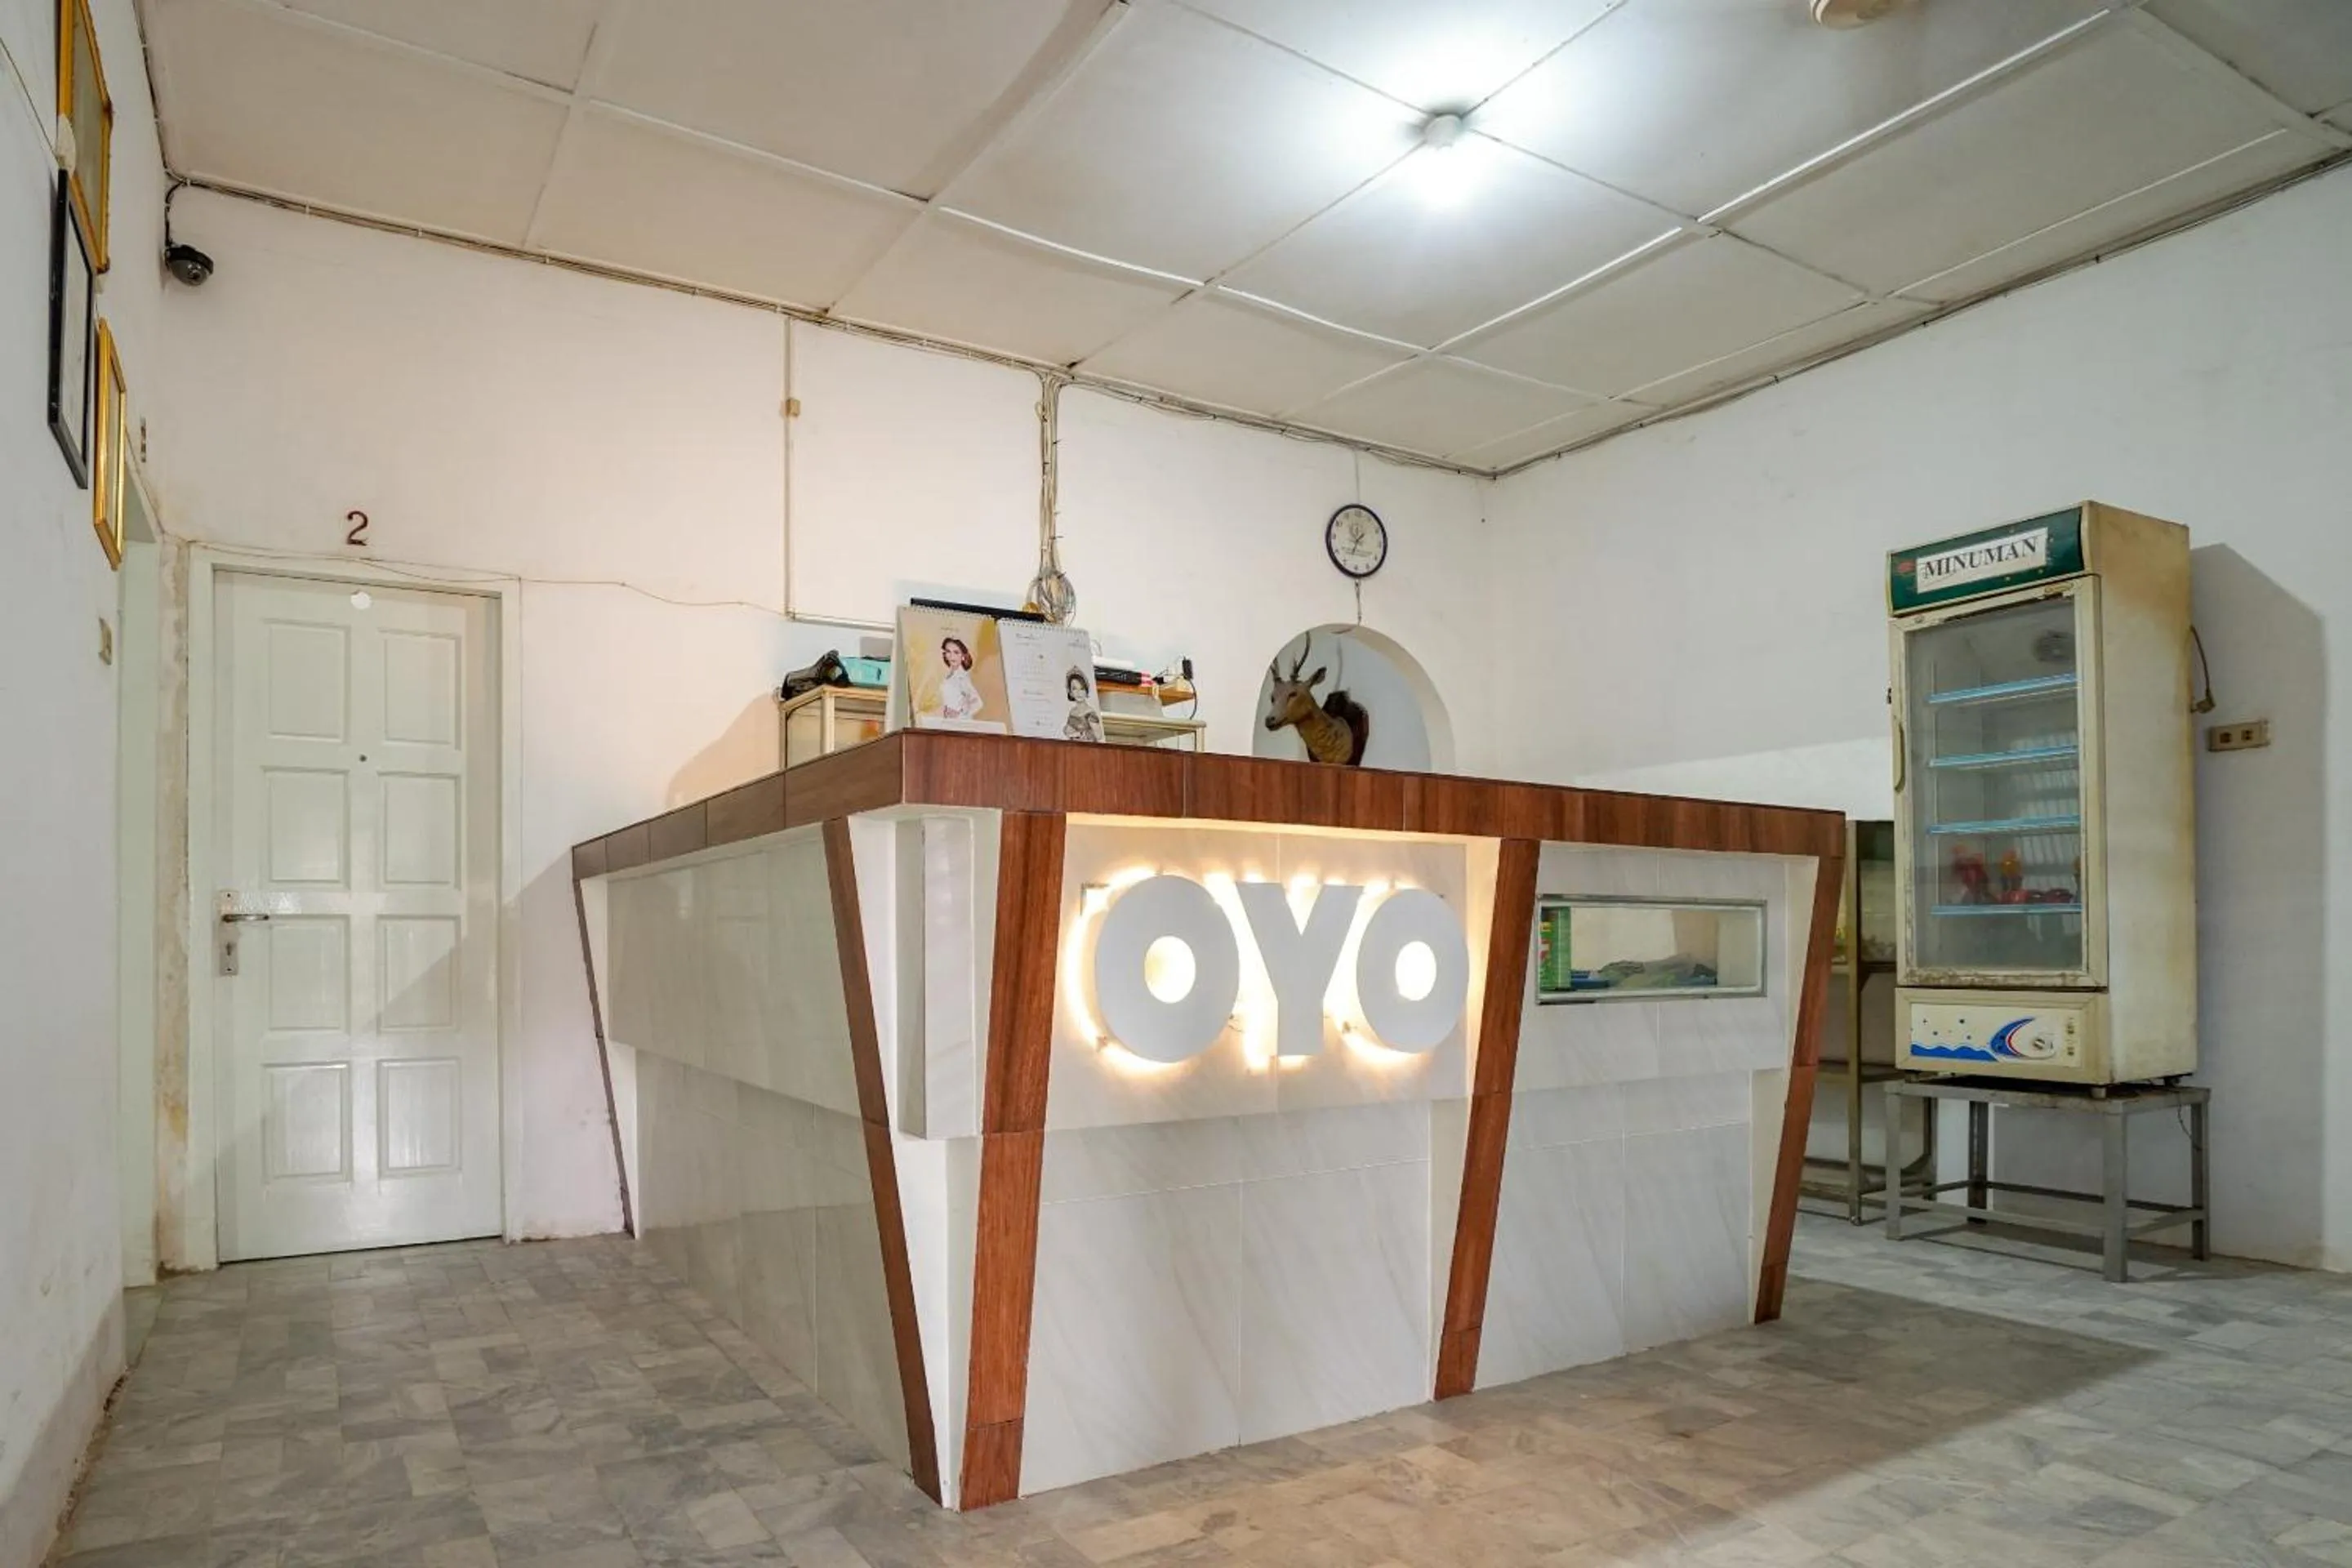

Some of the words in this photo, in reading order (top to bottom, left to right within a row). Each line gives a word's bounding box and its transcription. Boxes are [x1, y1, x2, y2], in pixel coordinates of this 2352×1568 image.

[347, 510, 368, 546] 2
[1924, 536, 2039, 579] MINUMAN
[1095, 874, 1469, 1062] OYO
